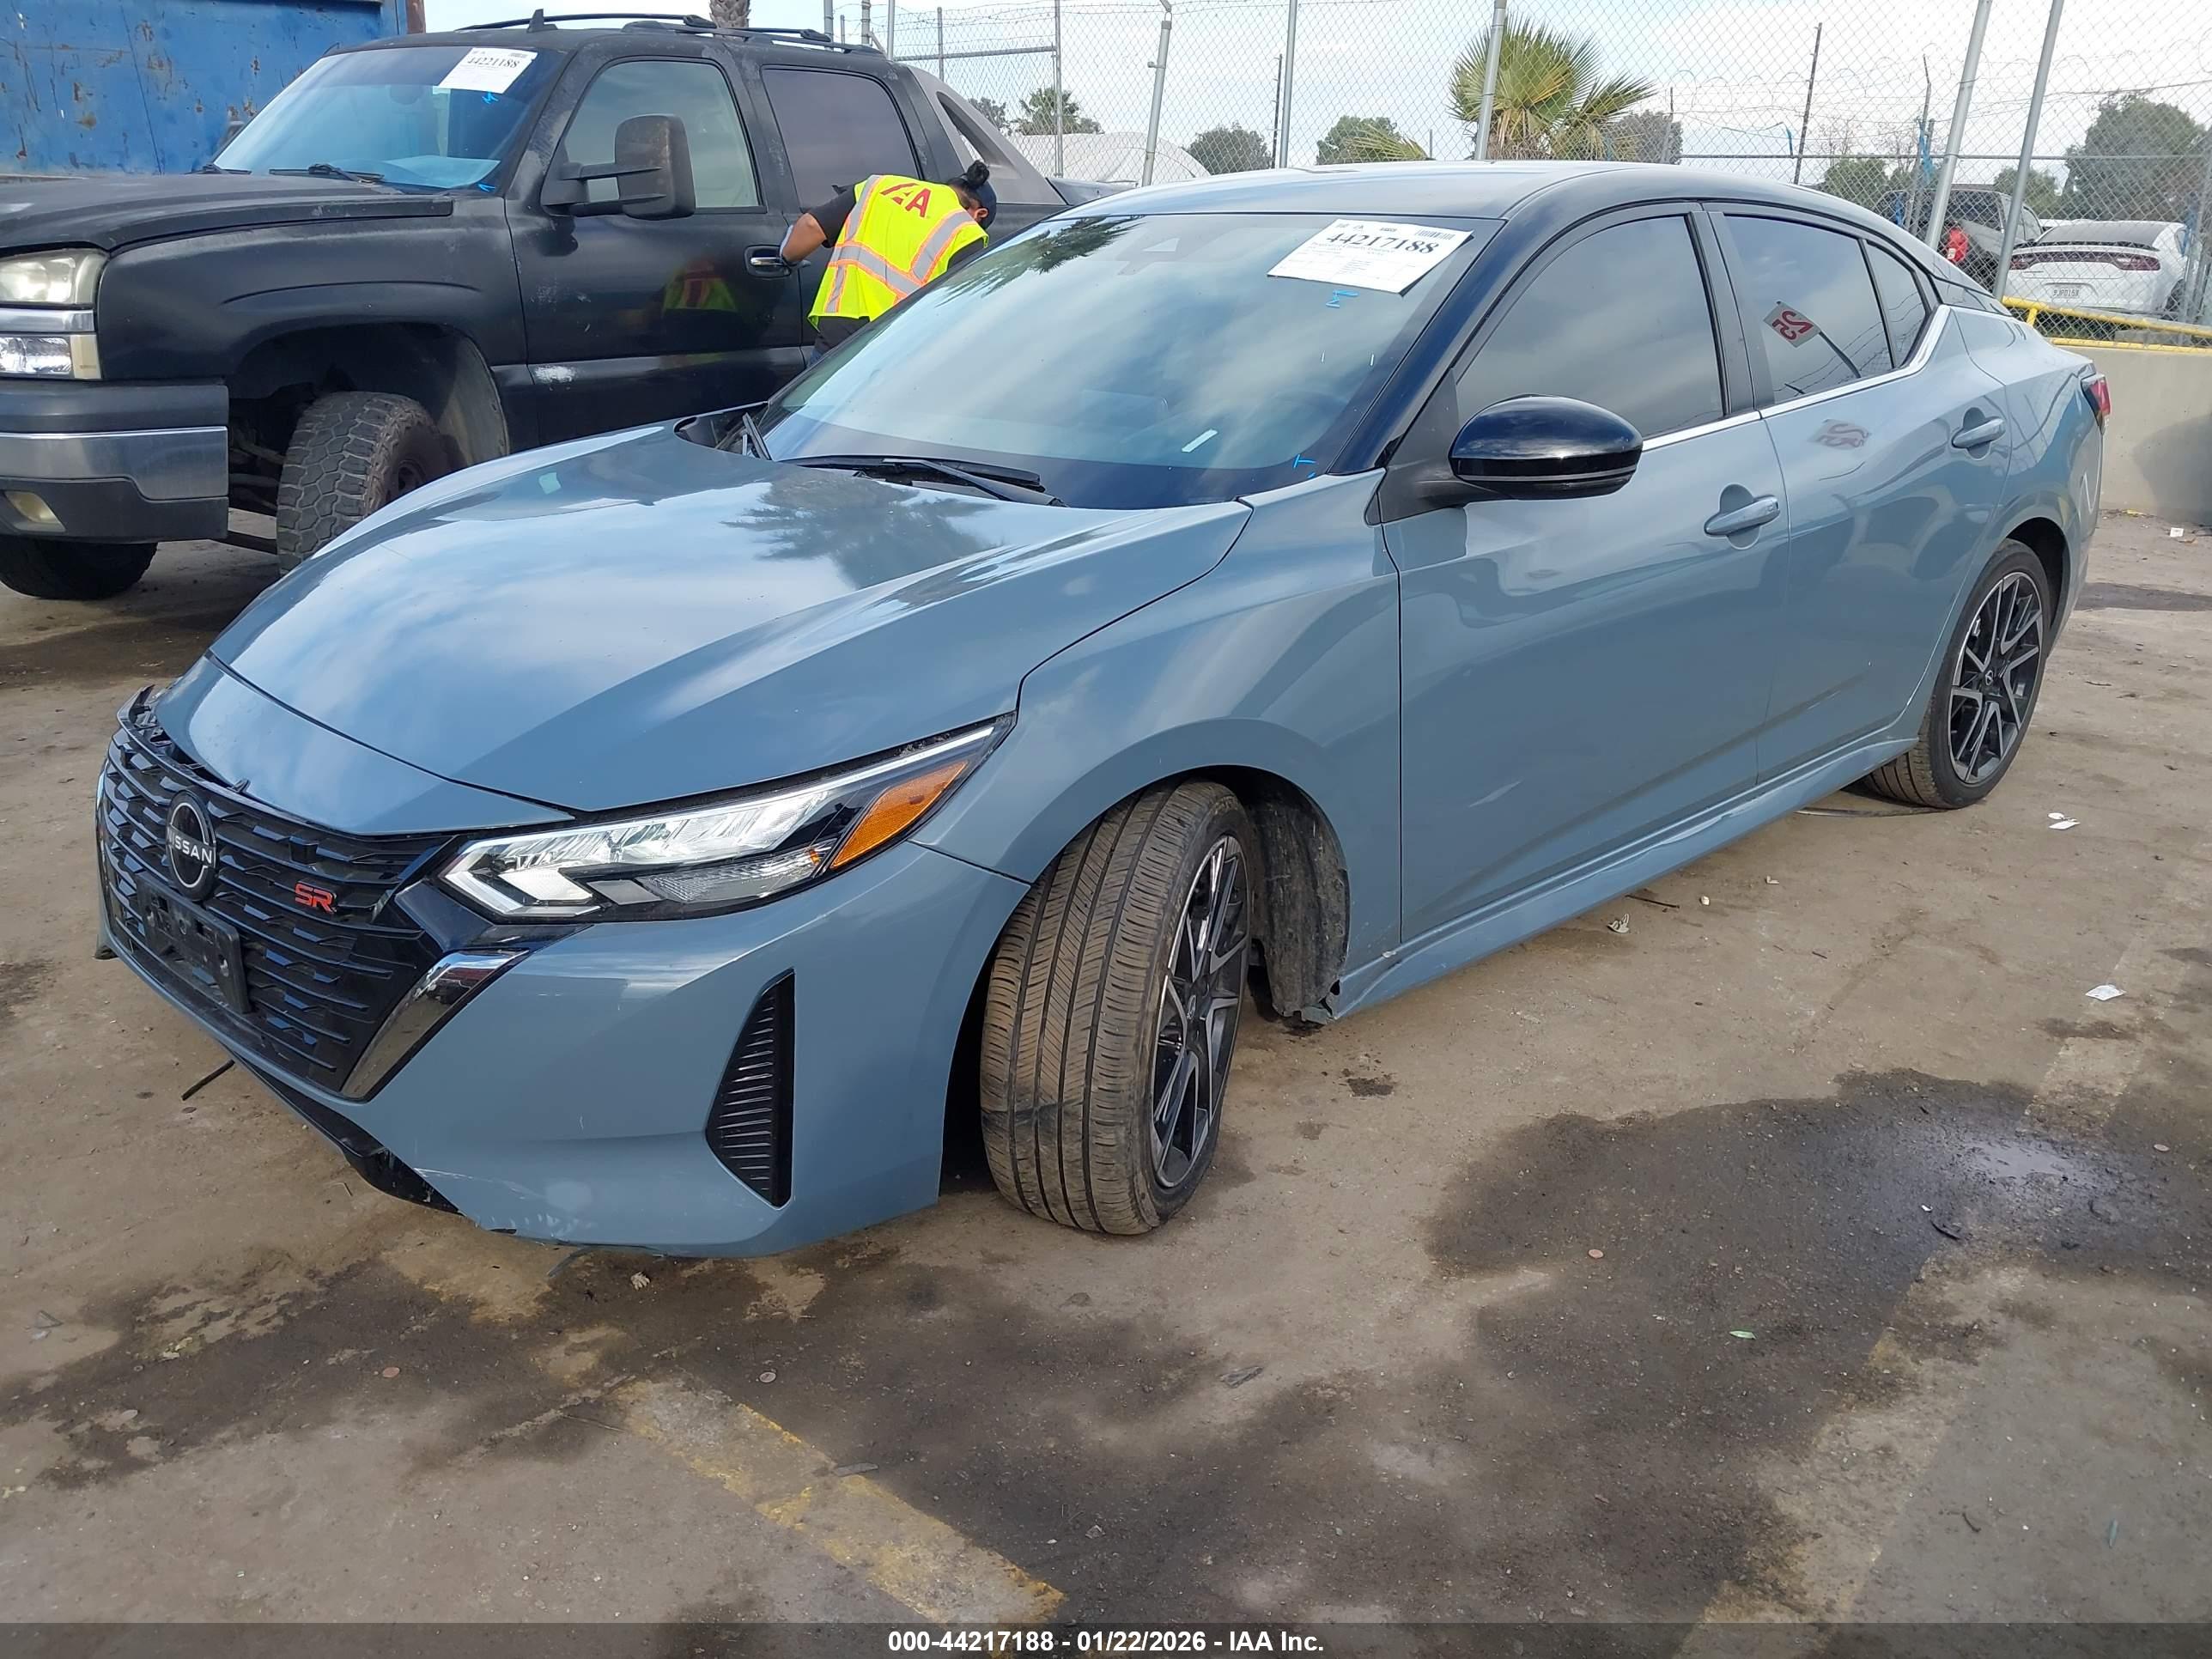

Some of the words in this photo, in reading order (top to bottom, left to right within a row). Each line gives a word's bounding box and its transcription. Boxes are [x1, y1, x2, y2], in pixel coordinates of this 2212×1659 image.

[1326, 232, 1440, 254] 44217188
[167, 825, 213, 865] NISSAN
[295, 880, 336, 915] SR
